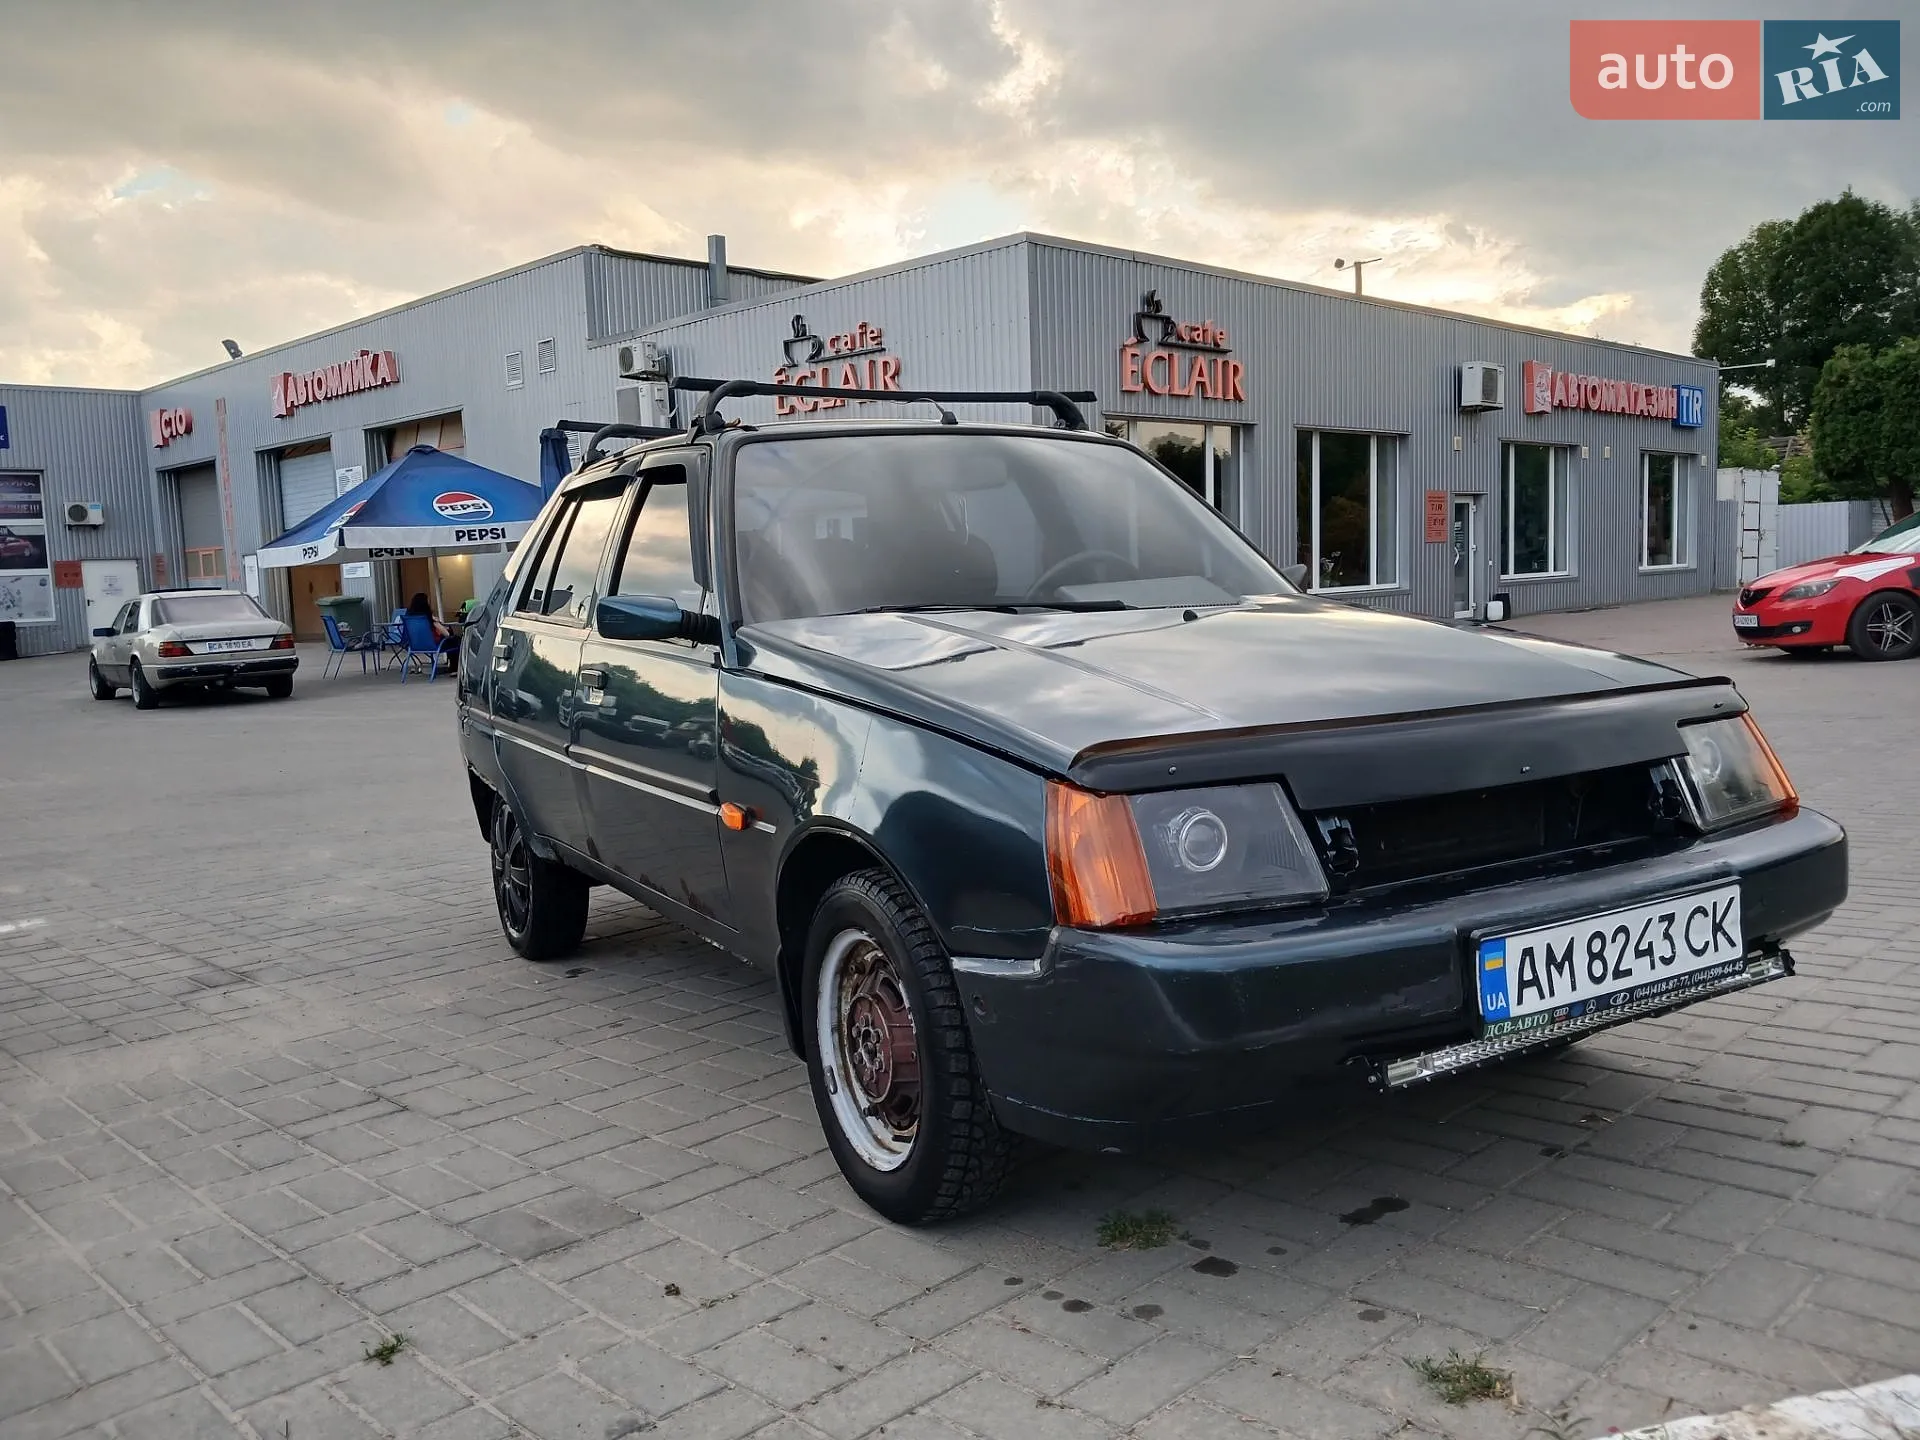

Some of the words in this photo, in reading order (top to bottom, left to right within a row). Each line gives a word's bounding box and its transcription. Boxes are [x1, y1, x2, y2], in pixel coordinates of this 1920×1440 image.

[828, 321, 883, 354] cafe
[1177, 320, 1227, 347] cafe
[1553, 371, 1678, 420] АВТОМАГАЗИН
[1680, 387, 1703, 425] TIR
[438, 503, 489, 513] PEPSI
[455, 527, 507, 542] PEPSI
[1516, 936, 1577, 1006] AM
[1586, 911, 1677, 985] 8243
[1684, 896, 1738, 958] CK
[1487, 992, 1508, 1011] UA
